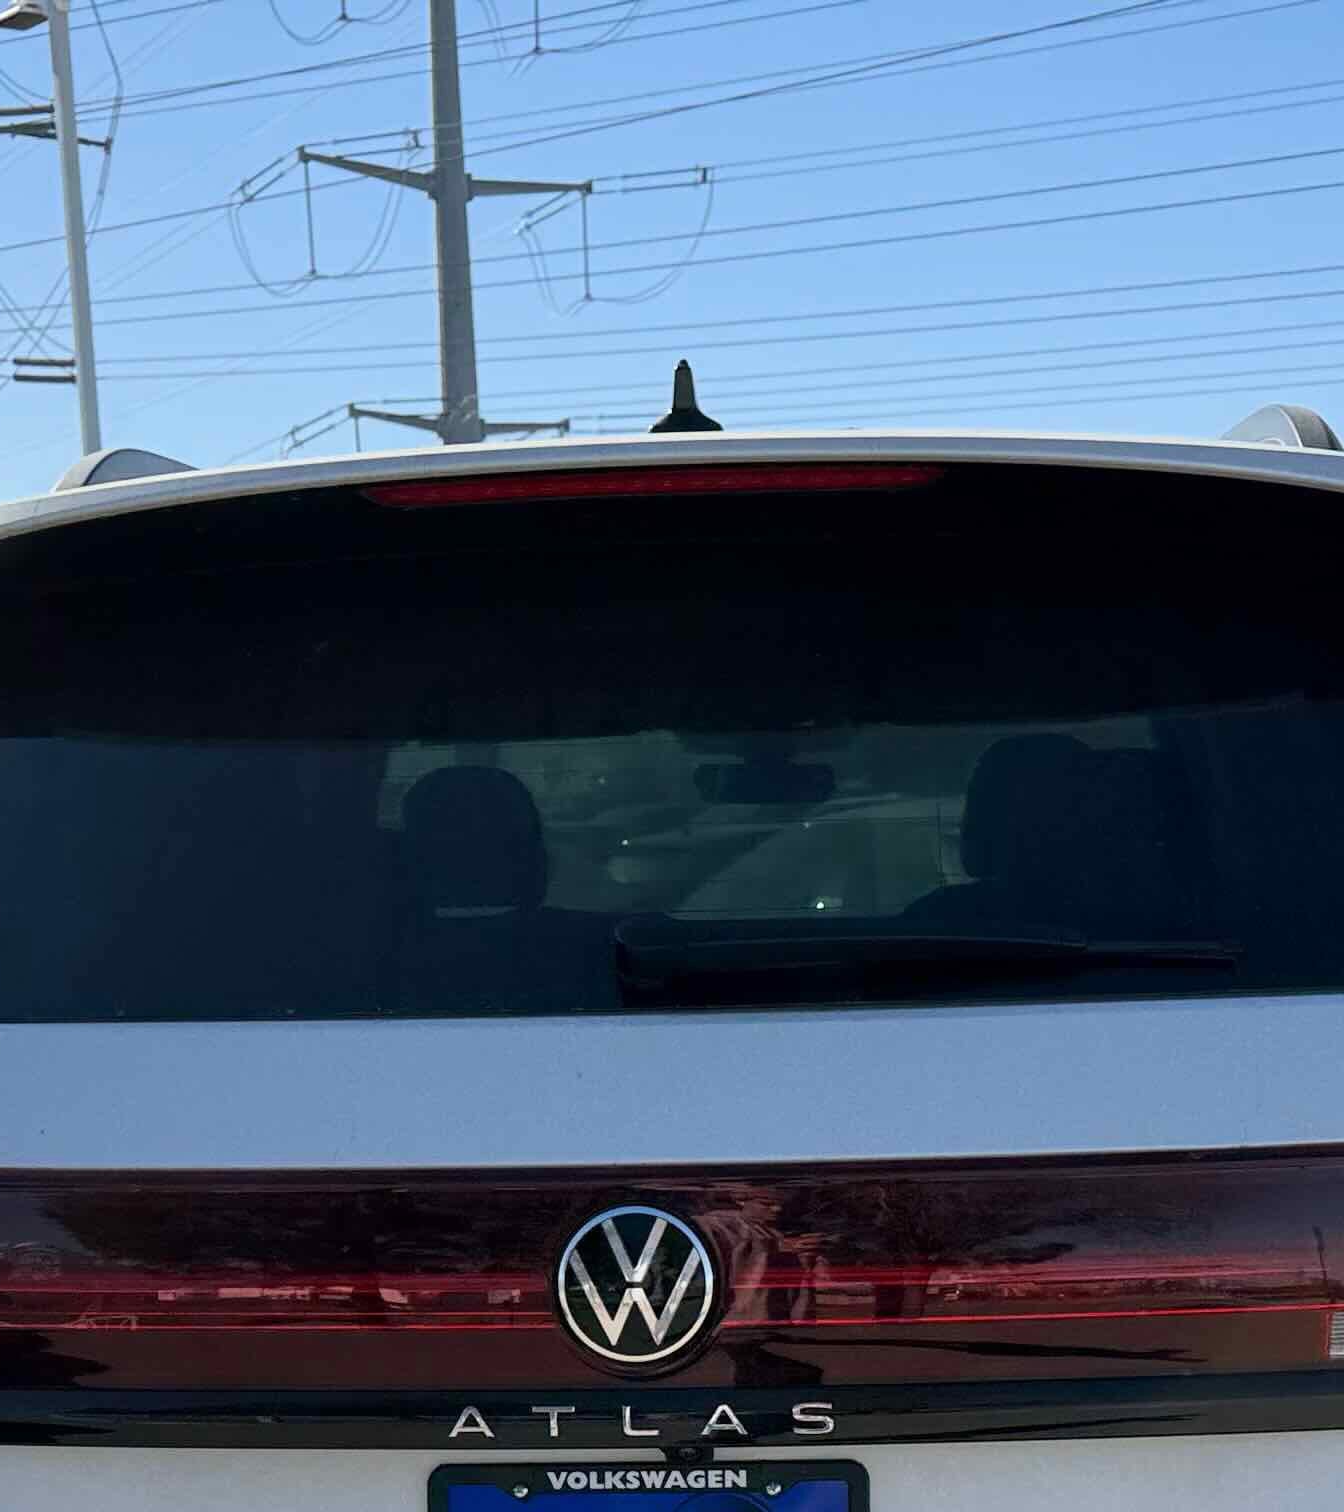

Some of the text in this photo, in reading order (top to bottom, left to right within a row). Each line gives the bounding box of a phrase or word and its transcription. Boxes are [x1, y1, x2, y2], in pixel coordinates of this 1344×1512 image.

[569, 1219, 701, 1346] VW
[448, 1403, 835, 1438] ATLAS
[547, 1470, 748, 1489] VOLKSWAGEN
